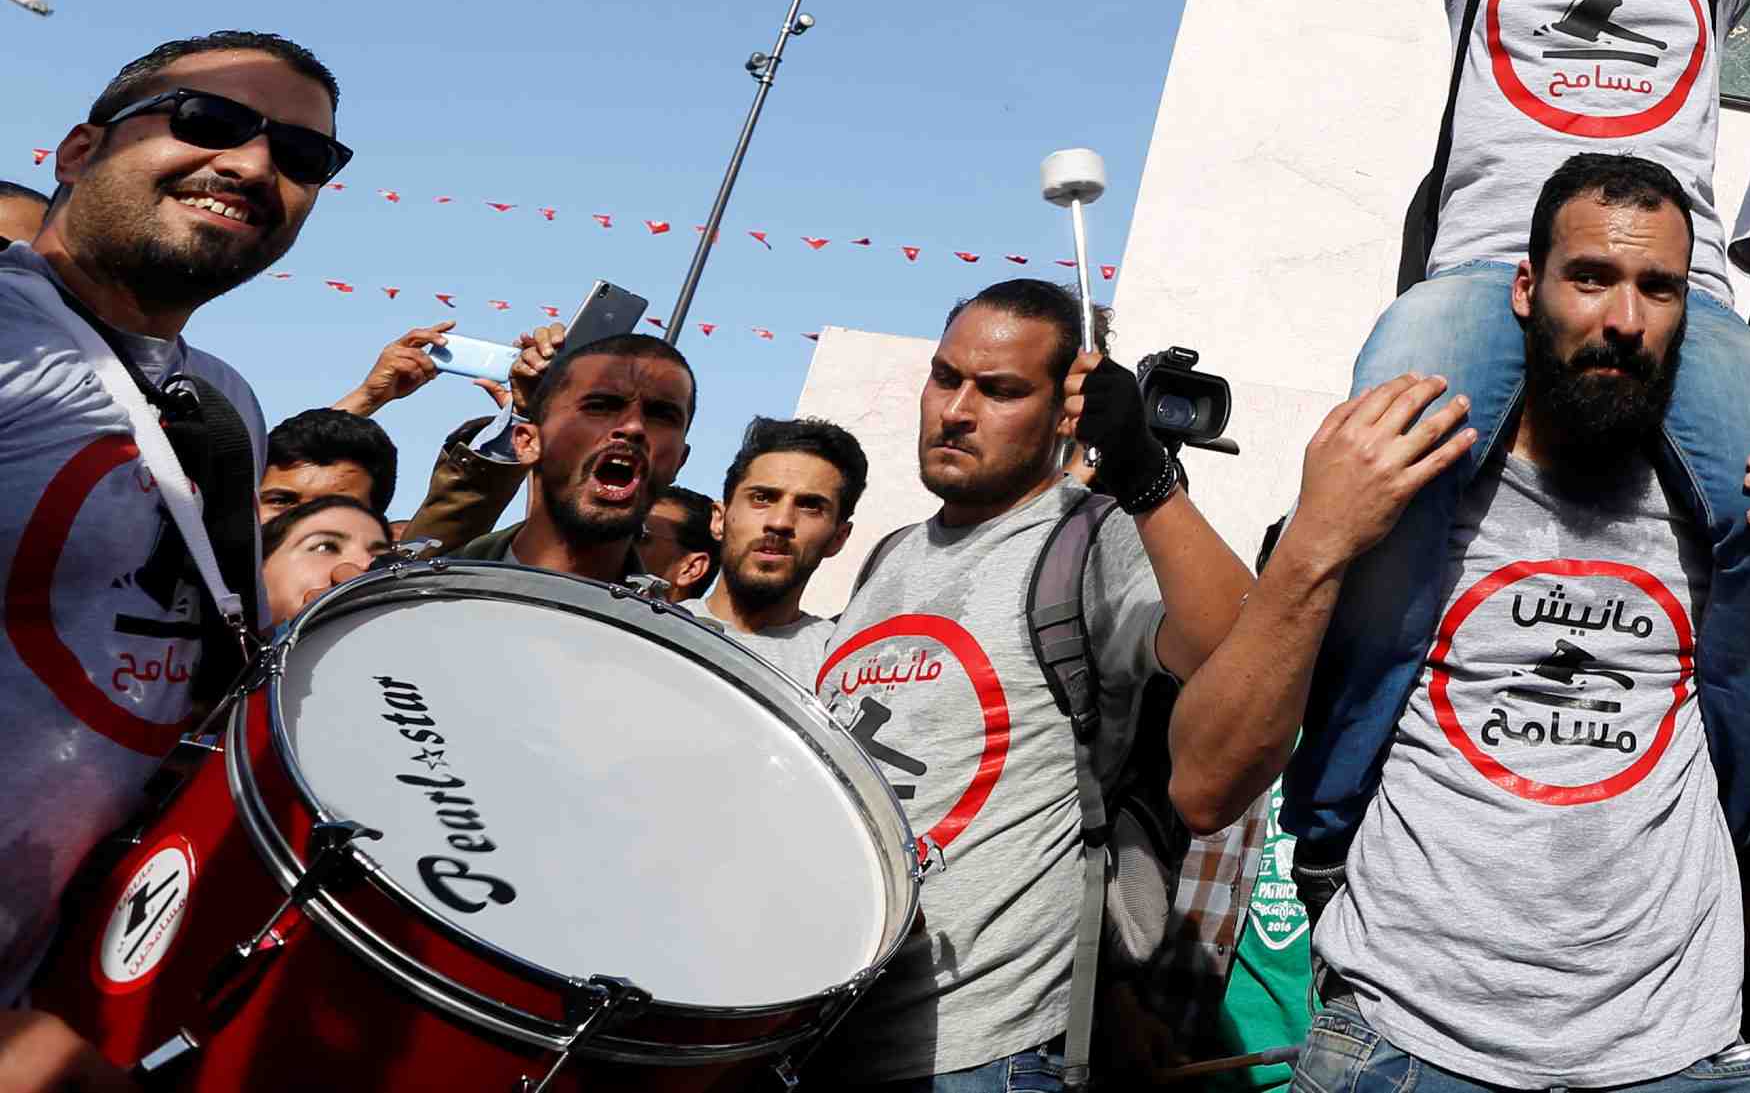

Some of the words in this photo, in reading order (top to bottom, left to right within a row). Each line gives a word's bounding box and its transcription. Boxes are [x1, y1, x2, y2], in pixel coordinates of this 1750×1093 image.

[1549, 65, 1652, 97] مسامح
[1511, 584, 1654, 638] مانيش
[841, 650, 943, 695] مانيش
[372, 675, 446, 745] star
[1481, 708, 1637, 754] مسامح
[394, 773, 517, 914] Pearl
[1266, 921, 1292, 932] 2016
